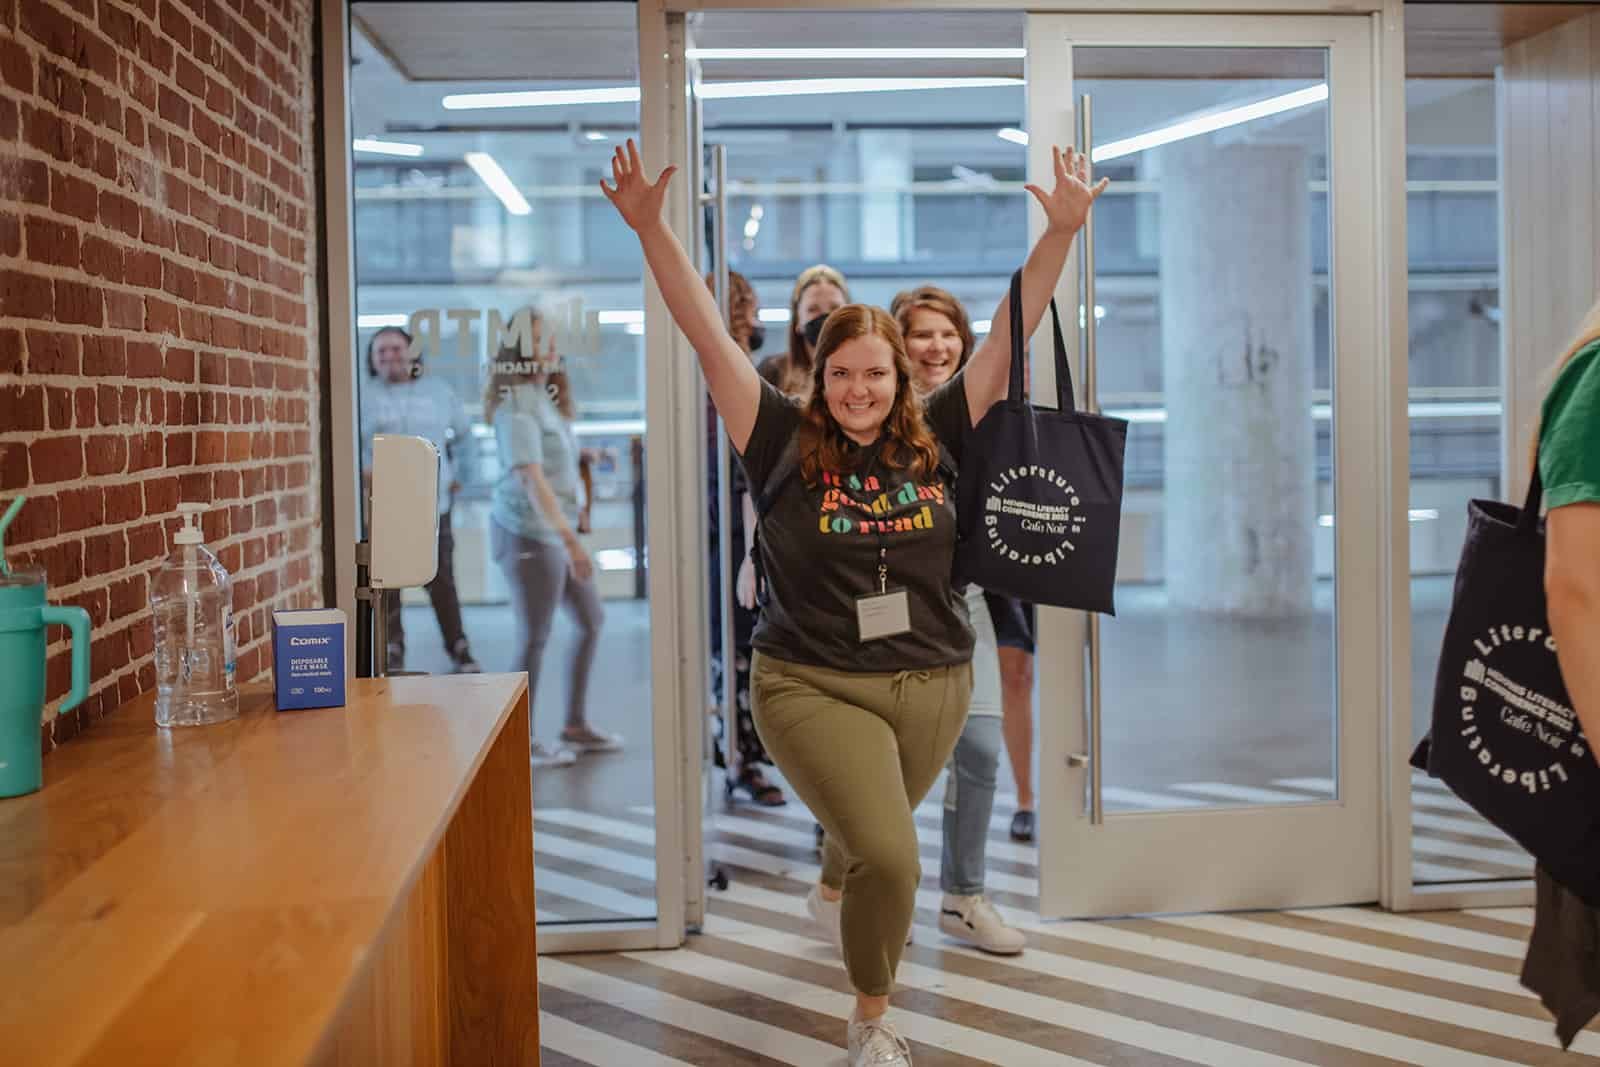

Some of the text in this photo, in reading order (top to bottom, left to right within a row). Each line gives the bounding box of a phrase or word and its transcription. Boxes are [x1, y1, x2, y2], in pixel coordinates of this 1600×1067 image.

[990, 465, 1080, 506] Literature
[819, 515, 852, 533] to
[985, 514, 1075, 565] Liberating
[1460, 686, 1568, 793] Liberating
